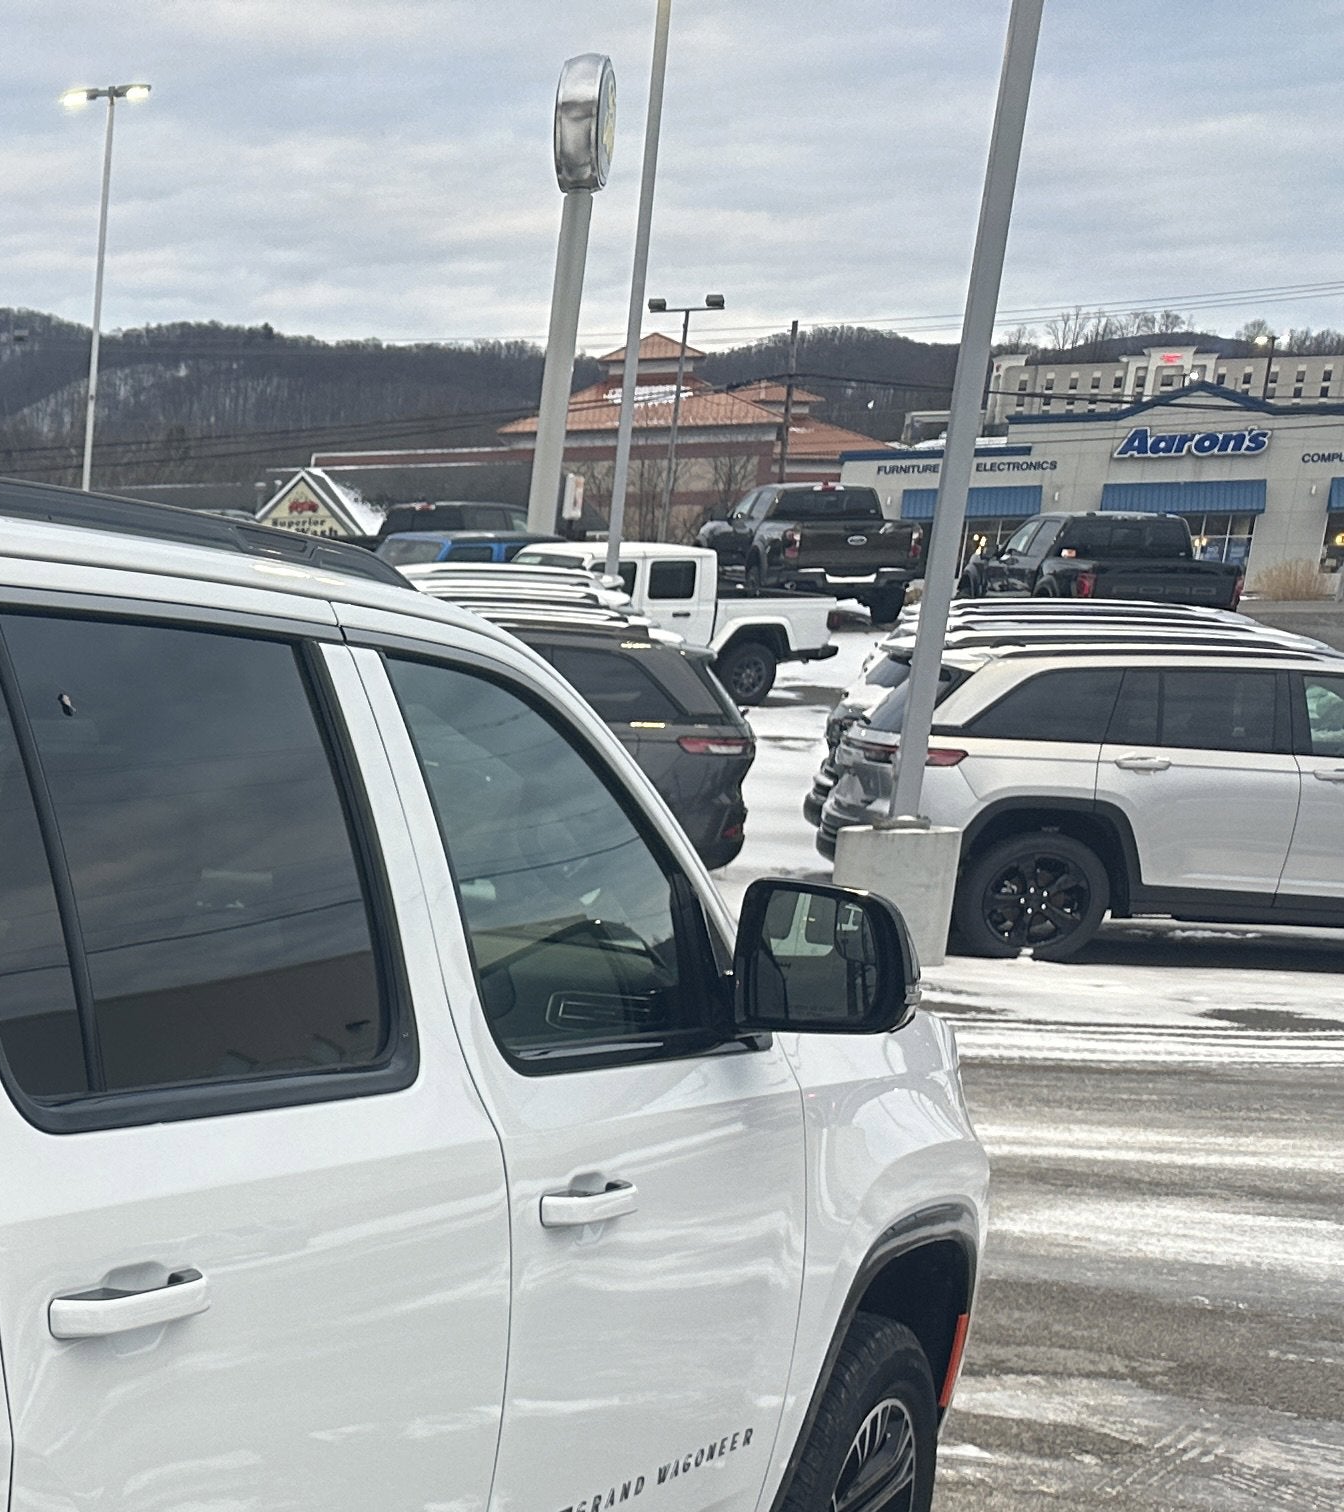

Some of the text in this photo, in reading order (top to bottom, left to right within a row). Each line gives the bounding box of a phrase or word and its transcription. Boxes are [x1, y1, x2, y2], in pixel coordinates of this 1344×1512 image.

[1115, 427, 1272, 459] Aaron's
[877, 463, 940, 476] FURNITURE
[976, 460, 1058, 474] ELECTRONICS
[1111, 585, 1217, 596] FORD
[657, 1428, 753, 1485] WAGONEER
